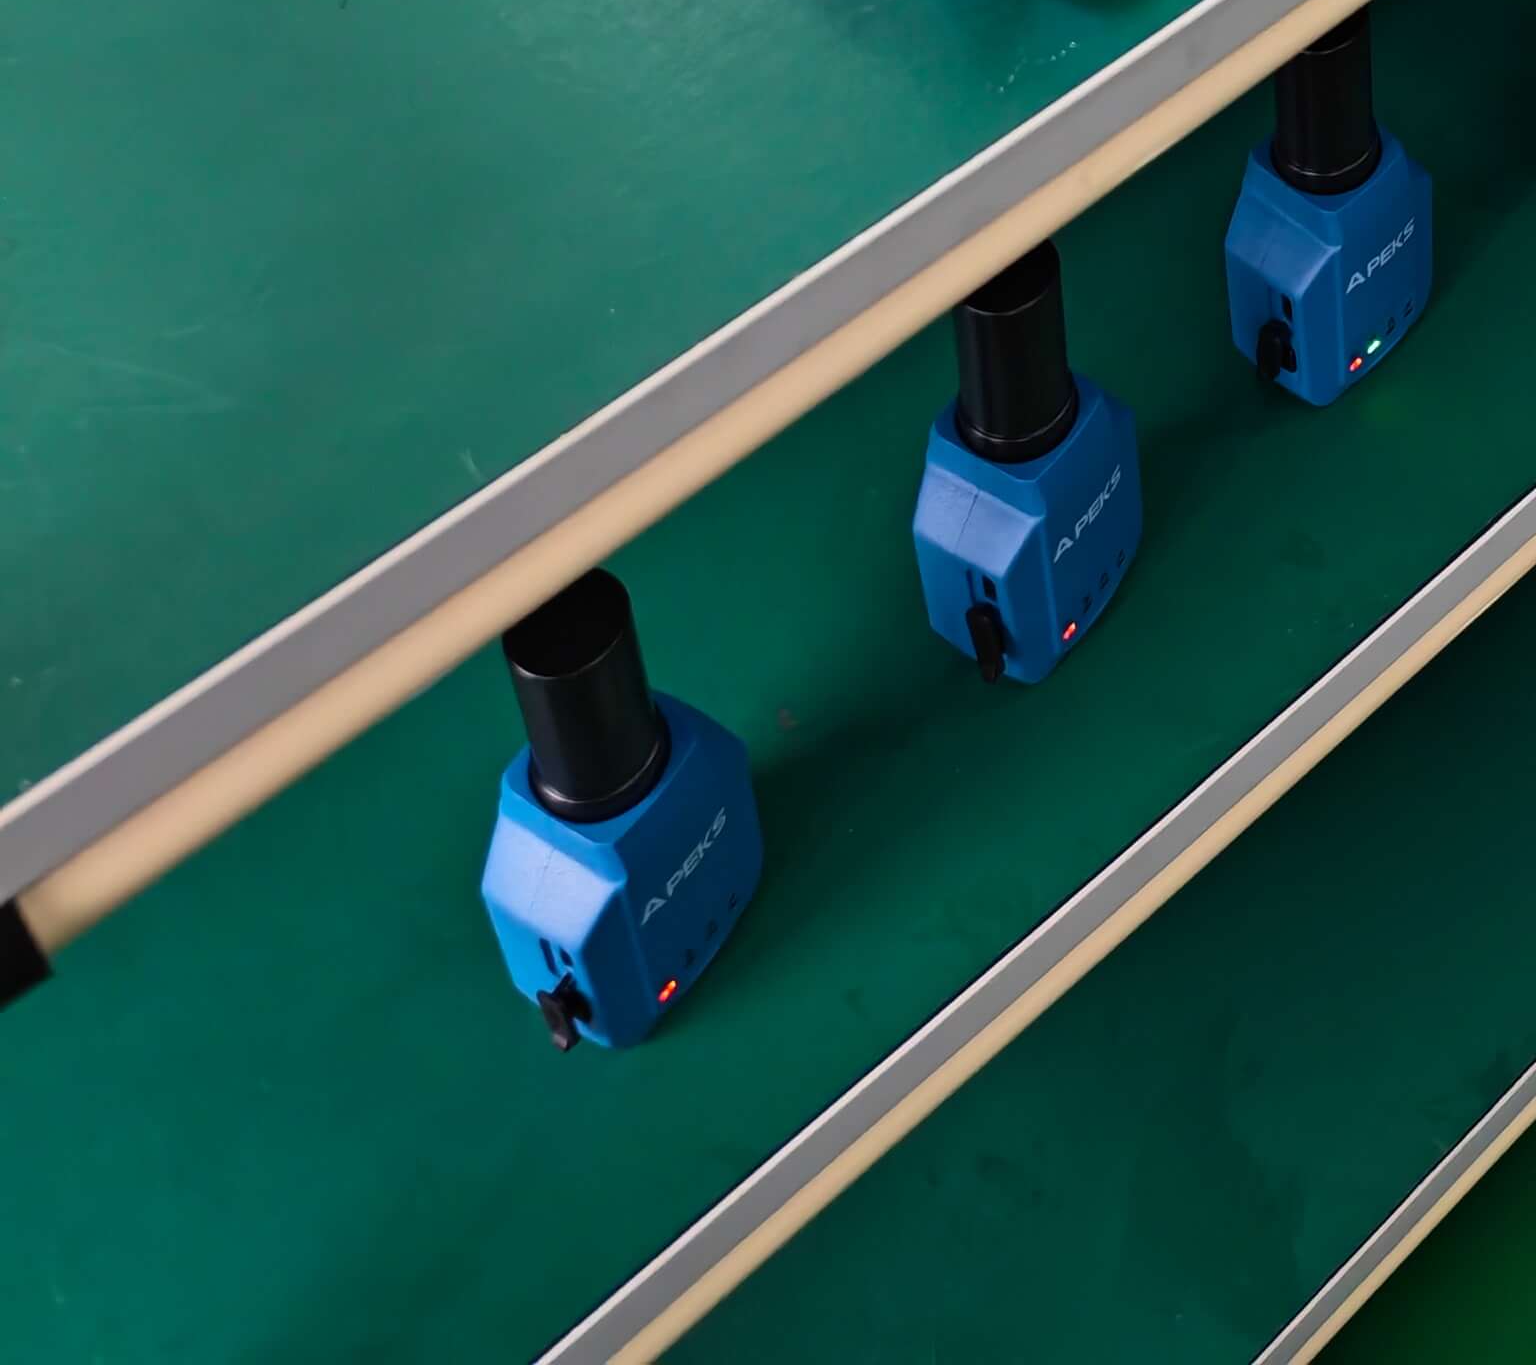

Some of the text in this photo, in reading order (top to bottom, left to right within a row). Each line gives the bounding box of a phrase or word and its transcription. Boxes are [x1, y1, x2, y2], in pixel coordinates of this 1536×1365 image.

[1345, 218, 1415, 294] APEKS
[1053, 464, 1121, 563] APEKS
[641, 807, 727, 926] APEKS
